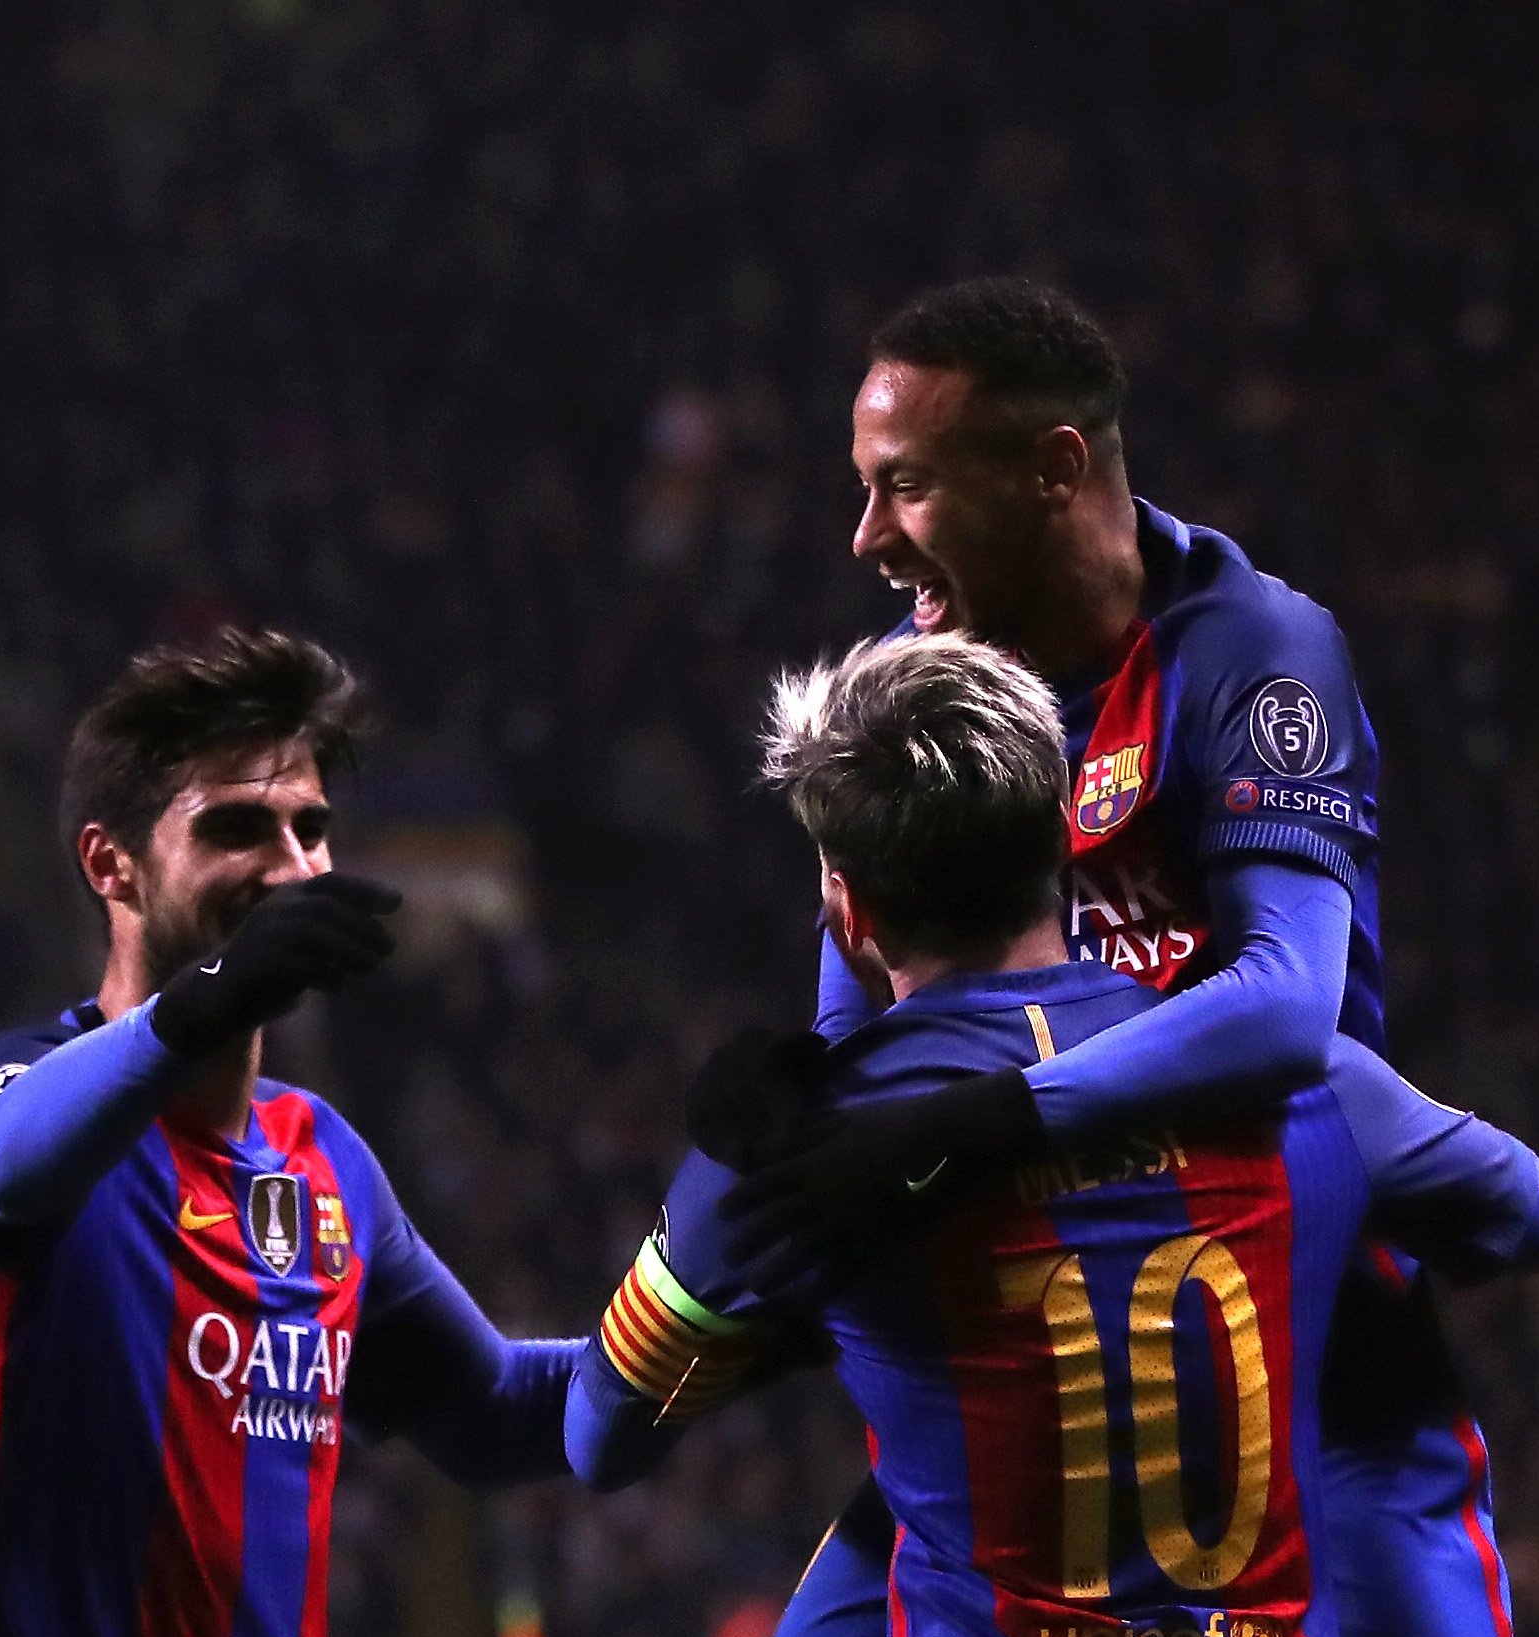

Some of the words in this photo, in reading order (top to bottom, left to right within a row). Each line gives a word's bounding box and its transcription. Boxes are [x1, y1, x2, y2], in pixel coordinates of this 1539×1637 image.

[1285, 726, 1300, 751] 5
[1263, 787, 1351, 823] RESPECT
[1070, 865, 1179, 937] AR
[996, 1234, 1271, 1599] 10
